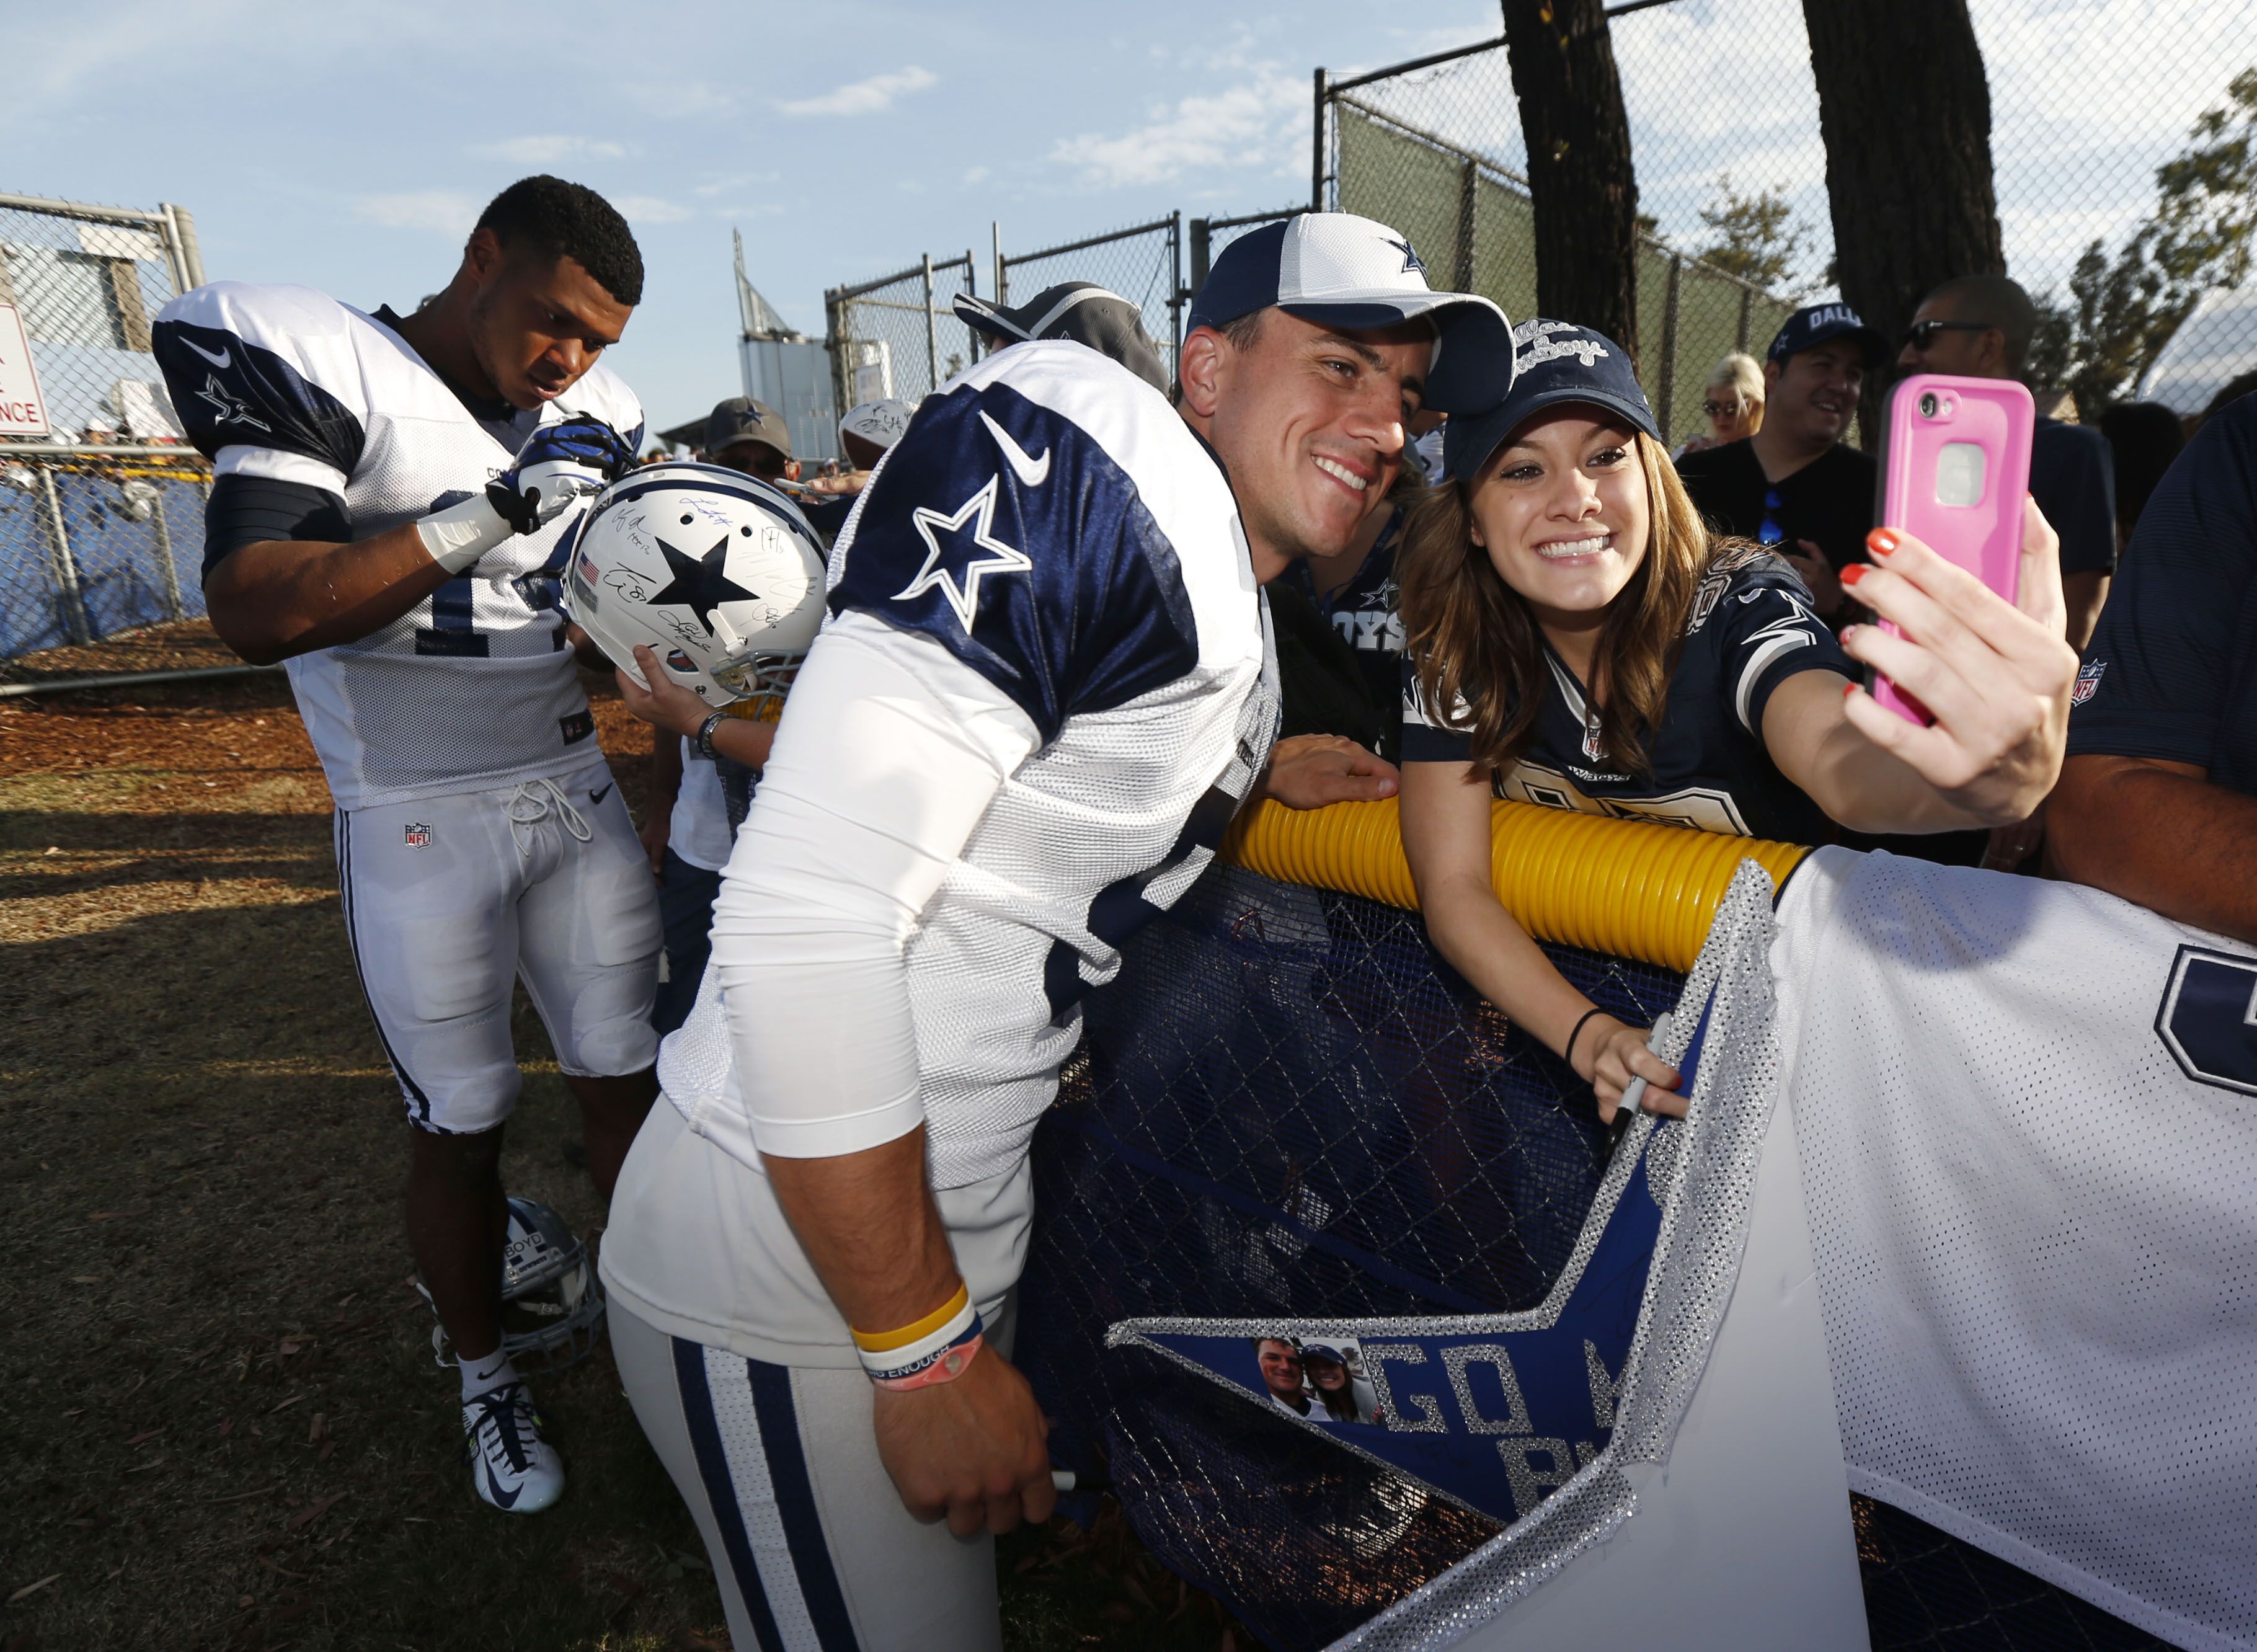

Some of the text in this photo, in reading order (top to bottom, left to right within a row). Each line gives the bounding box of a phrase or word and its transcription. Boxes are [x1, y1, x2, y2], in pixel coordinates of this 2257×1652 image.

[2072, 680, 2095, 700] NFL
[408, 833, 428, 846] NFL
[505, 1233, 542, 1258] BOYD
[888, 1344, 951, 1378] ENOUGH
[1364, 1343, 1534, 1434] GO
